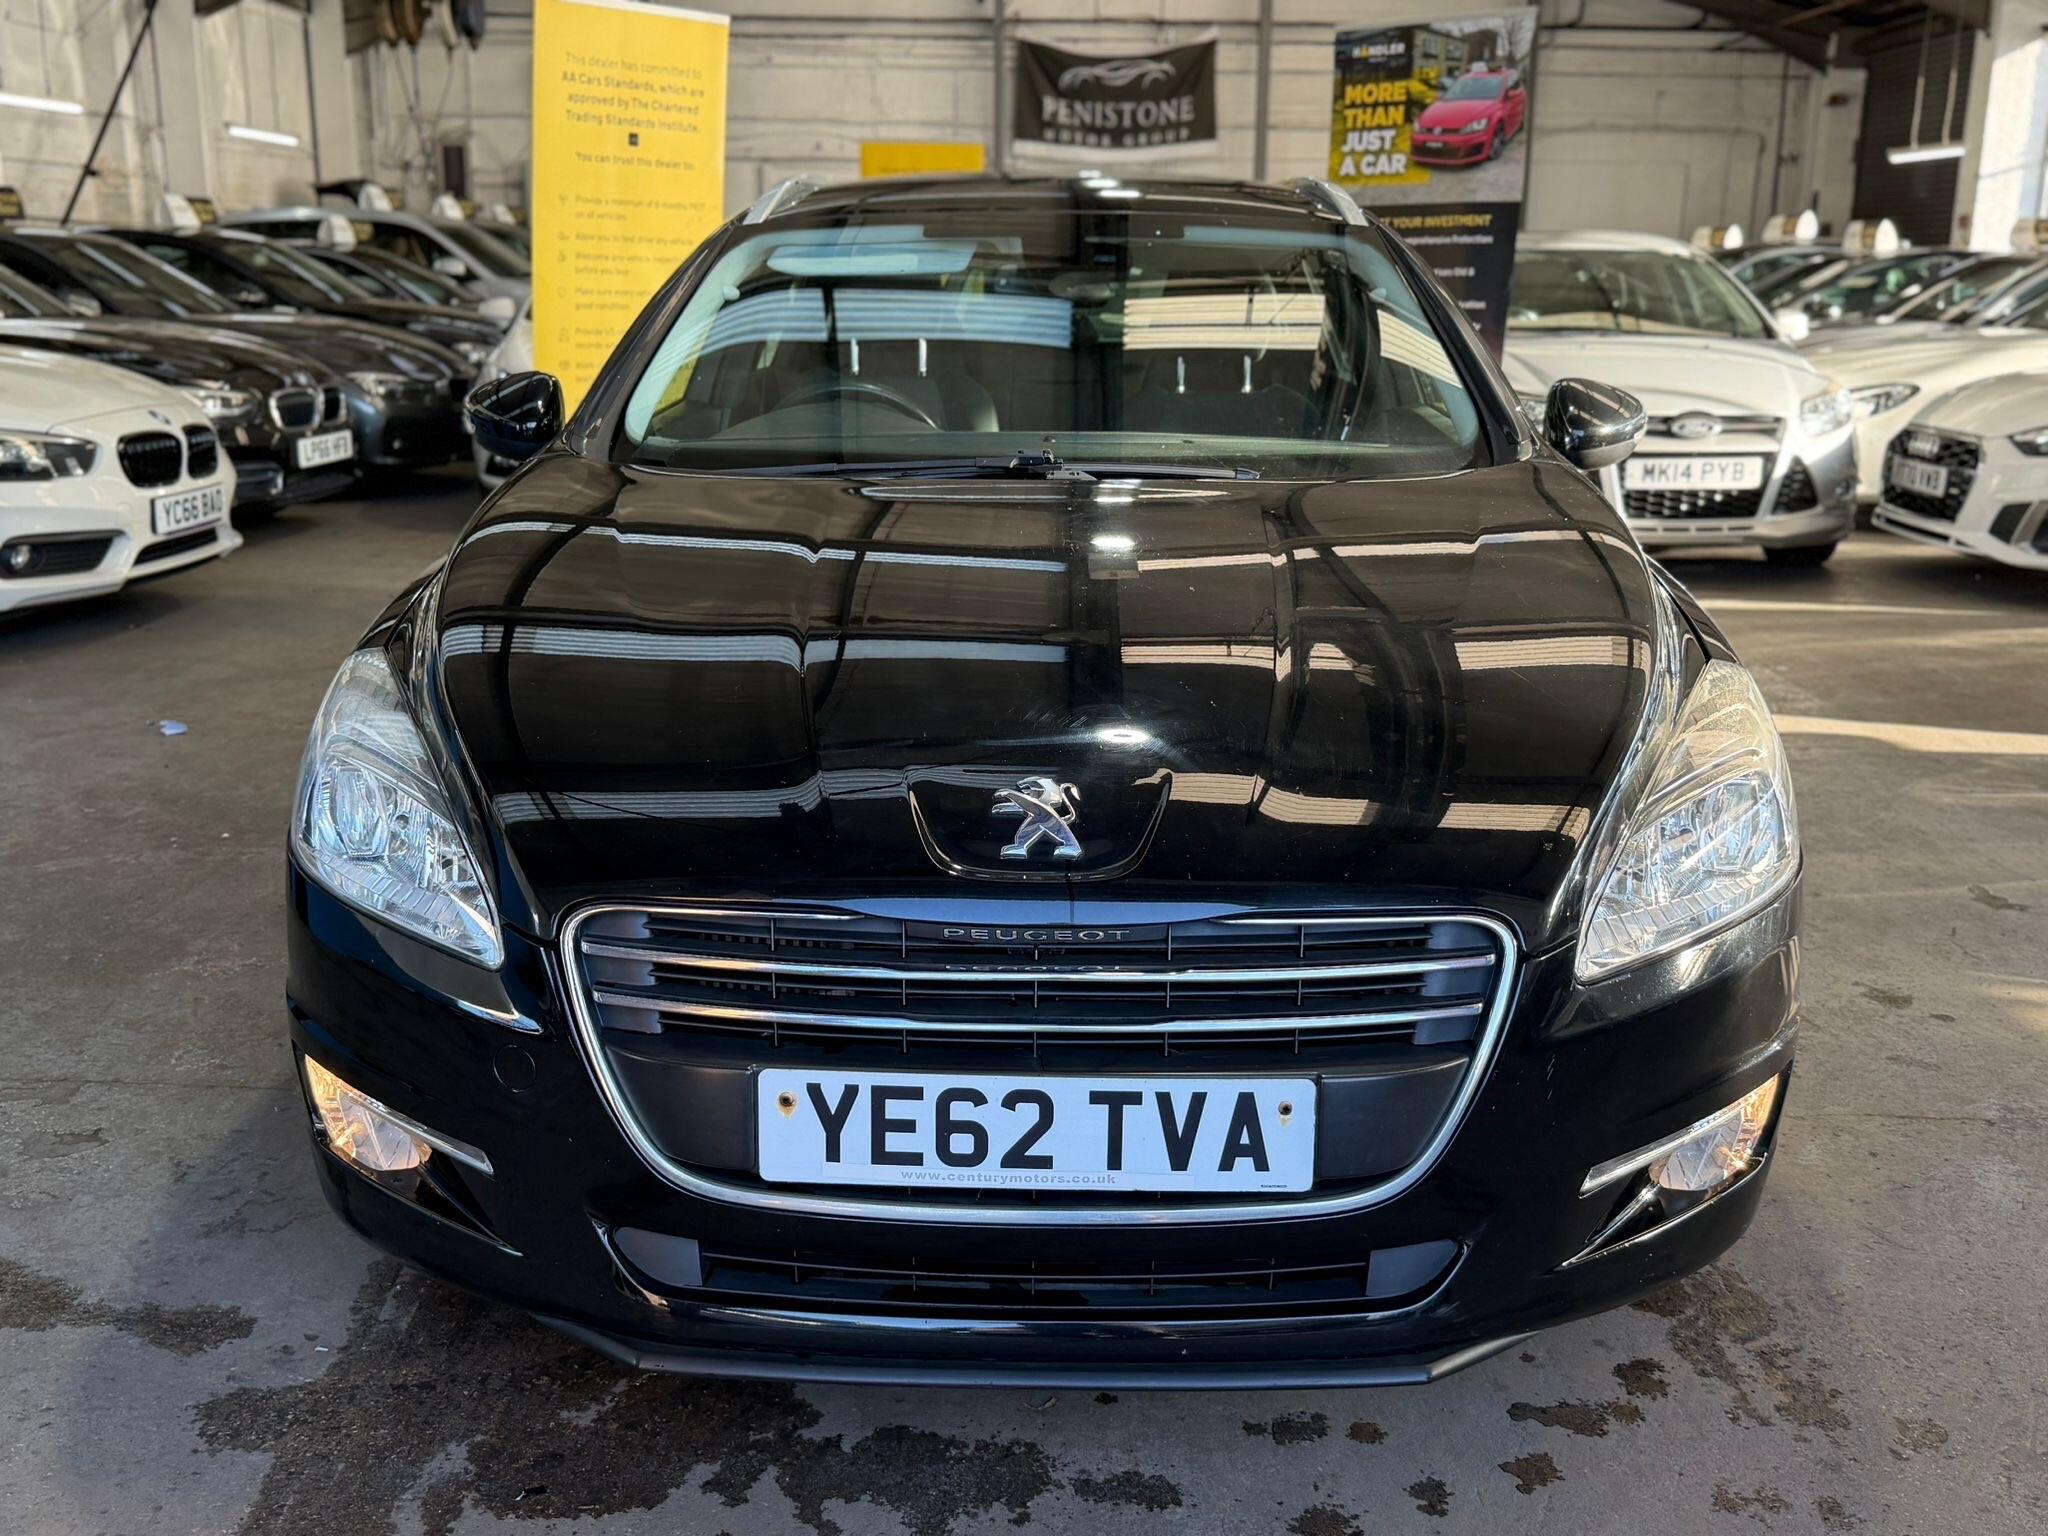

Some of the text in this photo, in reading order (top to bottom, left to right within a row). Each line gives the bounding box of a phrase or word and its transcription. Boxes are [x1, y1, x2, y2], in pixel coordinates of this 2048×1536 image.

[565, 52, 703, 80] This dealer has committed to
[561, 70, 705, 99] AA Cars Standards, which are
[1345, 81, 1408, 105] MORE
[568, 92, 699, 115] approved by The Chartered
[1041, 95, 1195, 129] PENISTONE
[566, 109, 603, 126] Trading
[605, 112, 656, 129] Standards
[1343, 105, 1405, 128] THAN
[1342, 129, 1396, 153] JUST
[575, 151, 593, 163] You
[594, 155, 611, 164] can
[612, 155, 635, 166] trust
[637, 156, 652, 167] this
[655, 158, 682, 170] dealer
[1339, 153, 1407, 176] A CAR
[1393, 216, 1424, 229] YOUR
[1425, 214, 1492, 227] INVESTMENT
[1641, 462, 1744, 482] MK14 PYB
[162, 493, 199, 527] YC66
[943, 928, 1130, 941] PEUGEOT
[806, 1082, 1270, 1173] YE62 TVA
[900, 1169, 1117, 1186] www.centurymotors.co.uk
